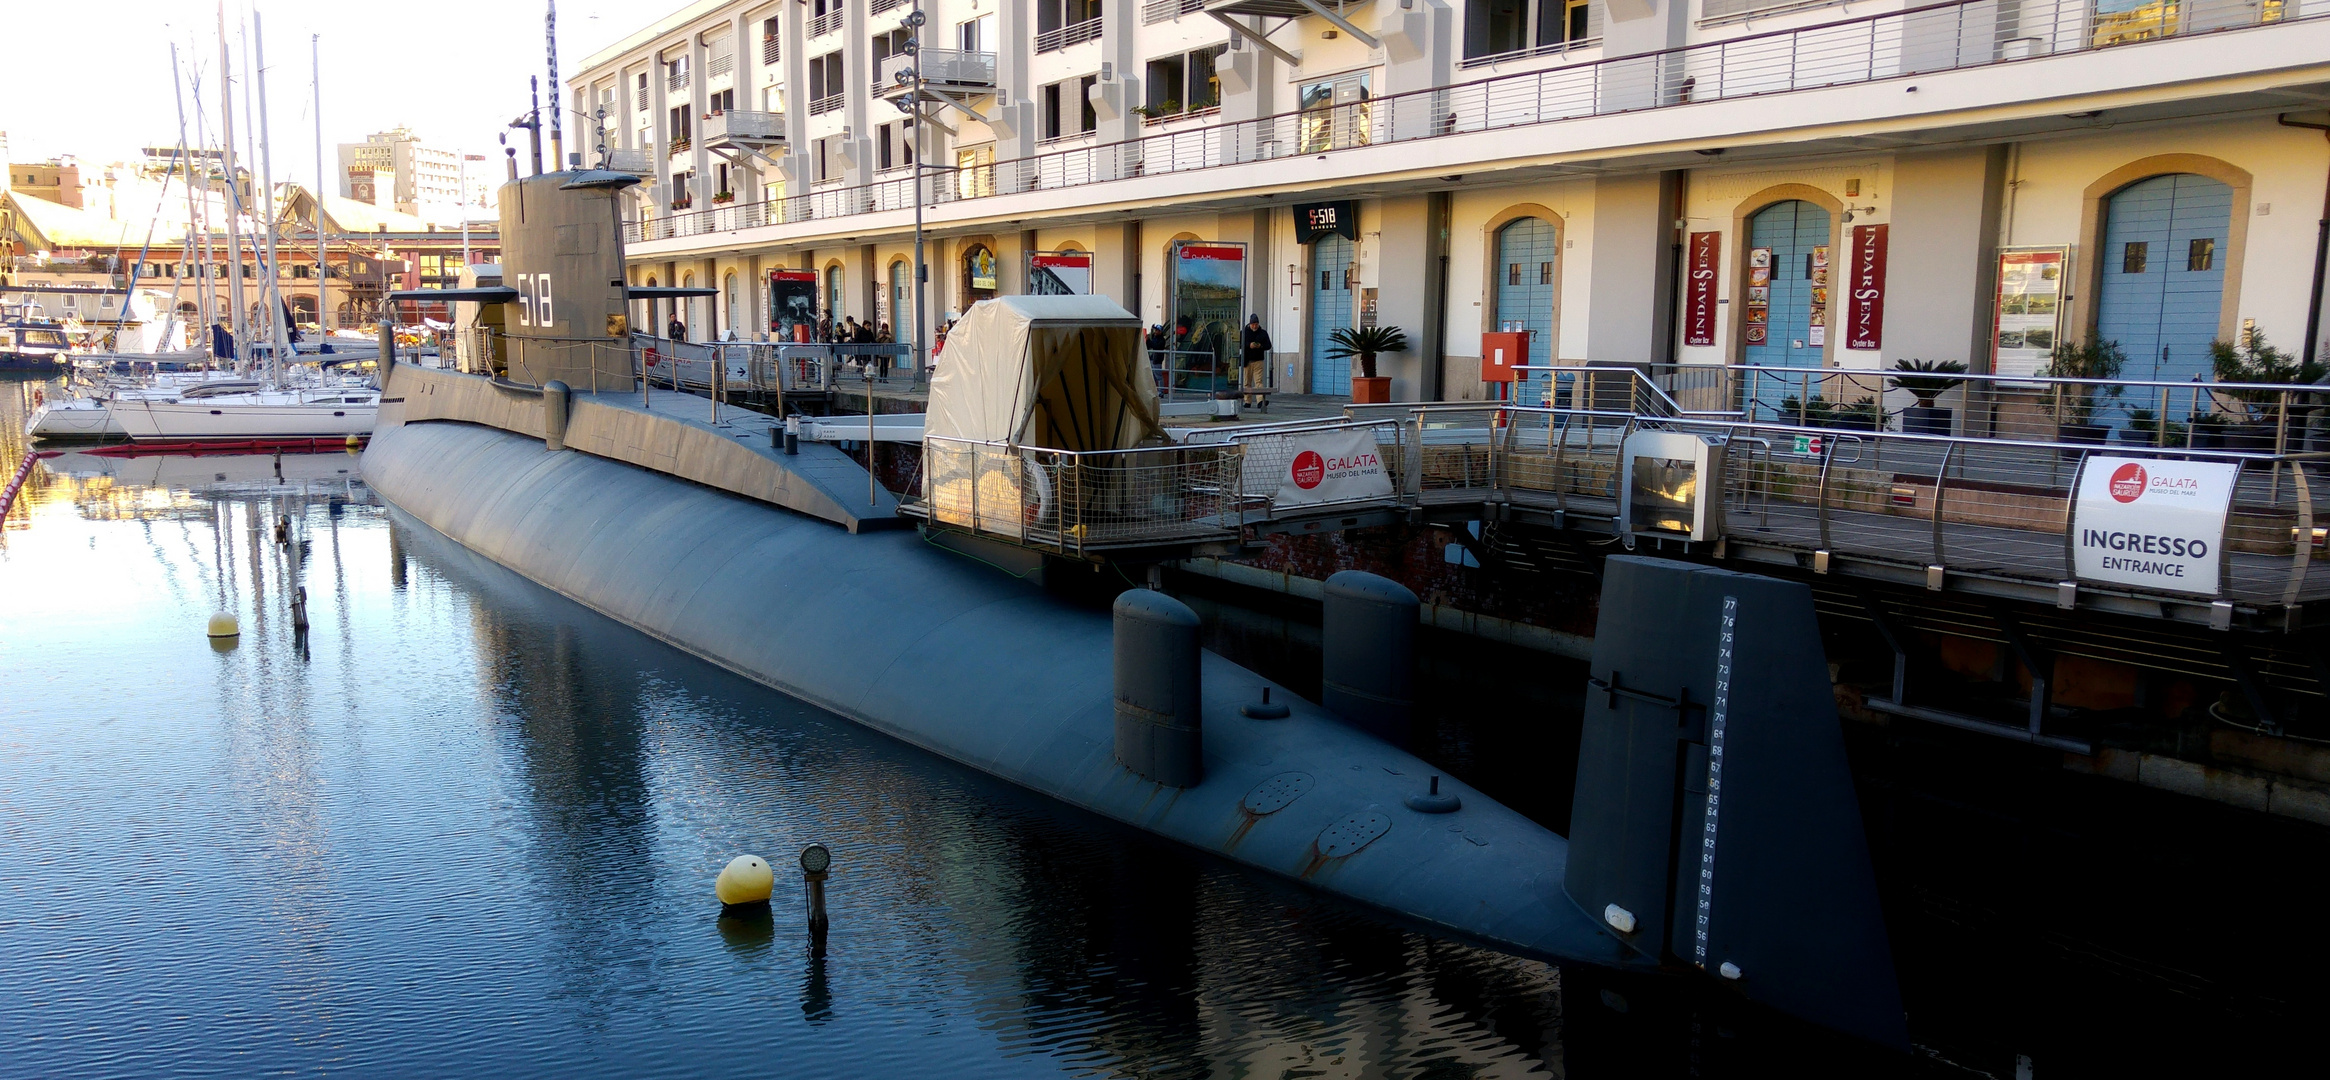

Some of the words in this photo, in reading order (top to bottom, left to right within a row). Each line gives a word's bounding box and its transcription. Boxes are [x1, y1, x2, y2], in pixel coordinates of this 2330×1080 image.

[1309, 207, 1336, 224] S-518
[1693, 234, 1714, 336] INDARSENA
[1855, 227, 1879, 338] INDARSENA
[517, 273, 553, 328] 518
[1362, 299, 1378, 312] S-51
[1690, 336, 1704, 344] Oyster
[1852, 339, 1866, 348] Oyster
[662, 354, 692, 365] GAATA
[1326, 454, 1378, 470] GALATA
[1326, 472, 1347, 480] MUSEO
[2151, 476, 2198, 490] GALATA
[2083, 528, 2208, 558] INGRESSO
[2102, 556, 2184, 578] ENTRANCE
[1725, 600, 1735, 610] 77
[1723, 616, 1734, 627] 76
[1722, 633, 1732, 642] 75
[1720, 648, 1731, 659] 74
[1719, 665, 1729, 674] 73
[1718, 681, 1727, 691] 72
[1716, 697, 1726, 707] 71
[1715, 713, 1724, 722] 70
[1714, 729, 1723, 739] 69
[1712, 745, 1722, 756] 68
[1711, 762, 1720, 772] 67
[1709, 794, 1718, 805] 65
[1708, 807, 1717, 817] 64
[1706, 823, 1716, 833] 63
[1705, 838, 1714, 849] 62
[1703, 854, 1713, 863] 61
[1702, 869, 1712, 880] 60
[1701, 884, 1710, 895] 59
[1700, 899, 1709, 910] 58
[1698, 915, 1708, 925] 57
[1697, 930, 1707, 941] 56
[1696, 946, 1705, 956] 55
